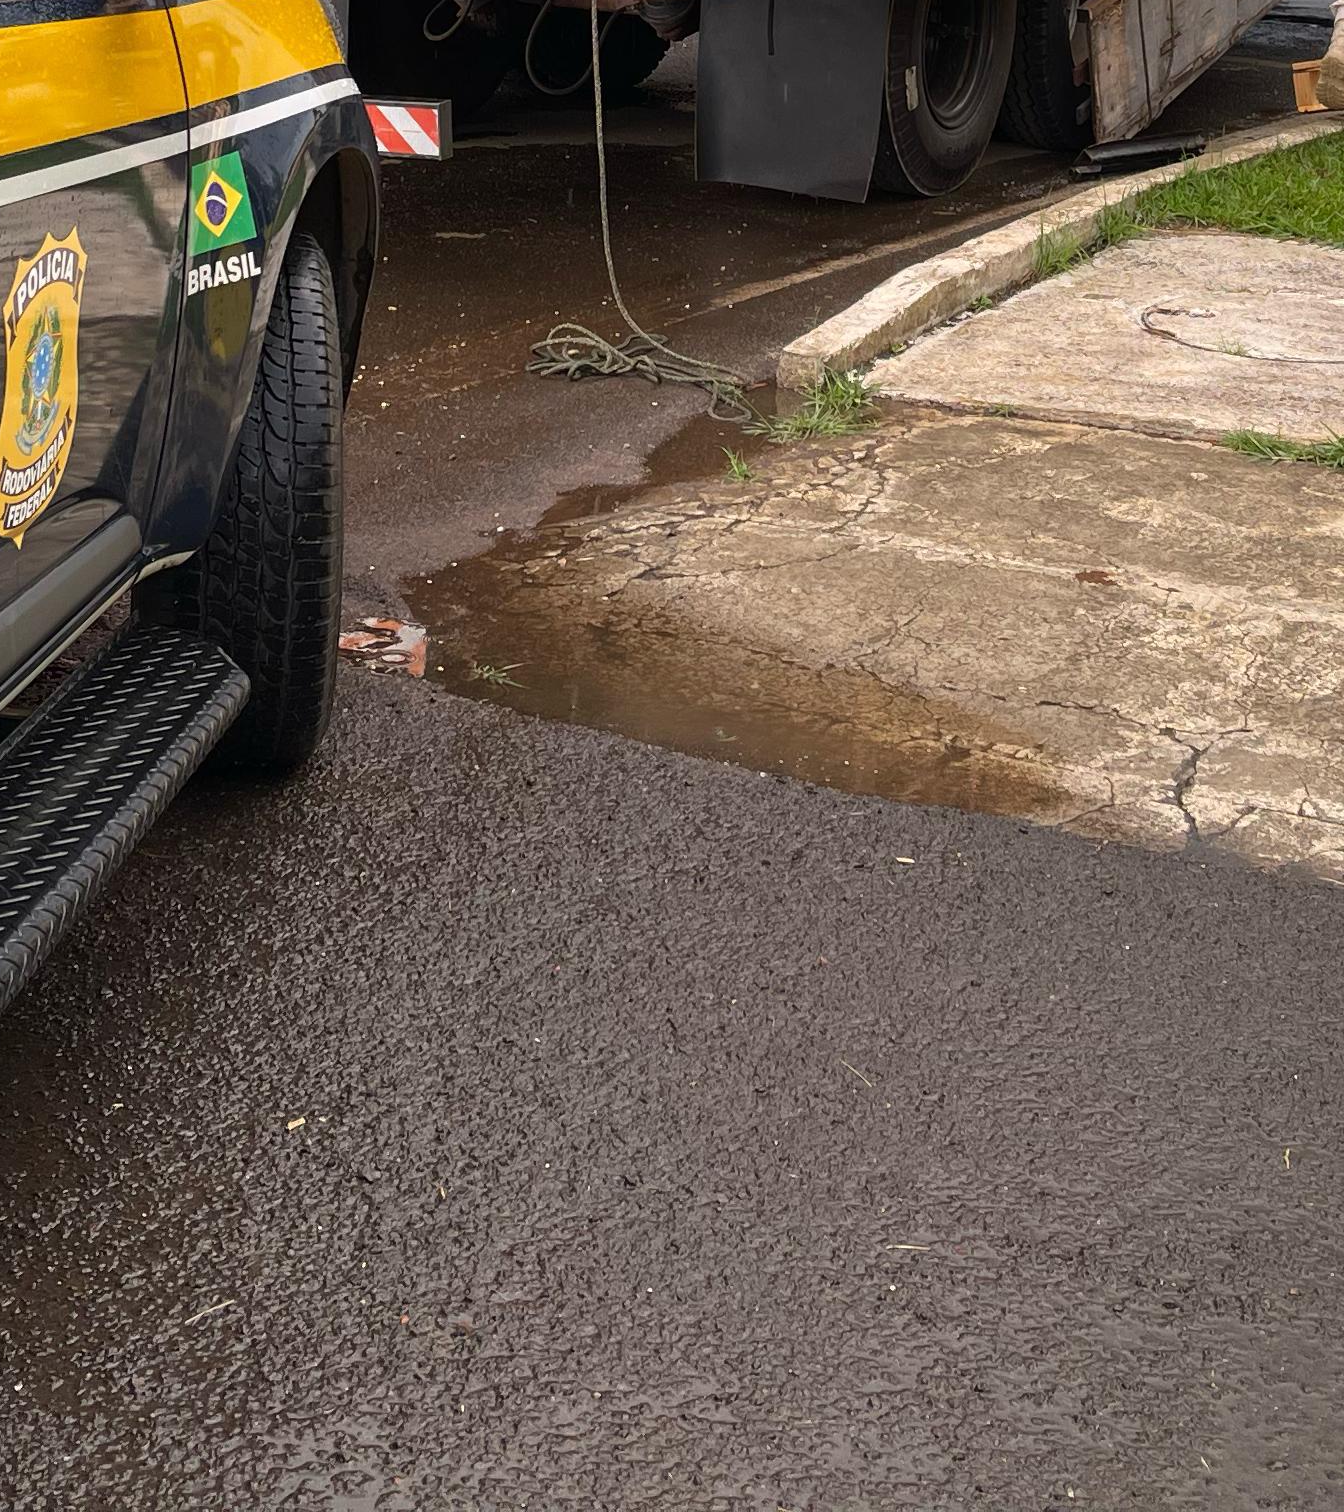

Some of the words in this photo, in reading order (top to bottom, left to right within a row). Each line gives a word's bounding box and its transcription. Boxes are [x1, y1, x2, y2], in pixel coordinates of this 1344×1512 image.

[187, 251, 262, 296] BRASIL
[2, 430, 65, 495] RODOVIARIA
[6, 476, 53, 528] FEDERAL
